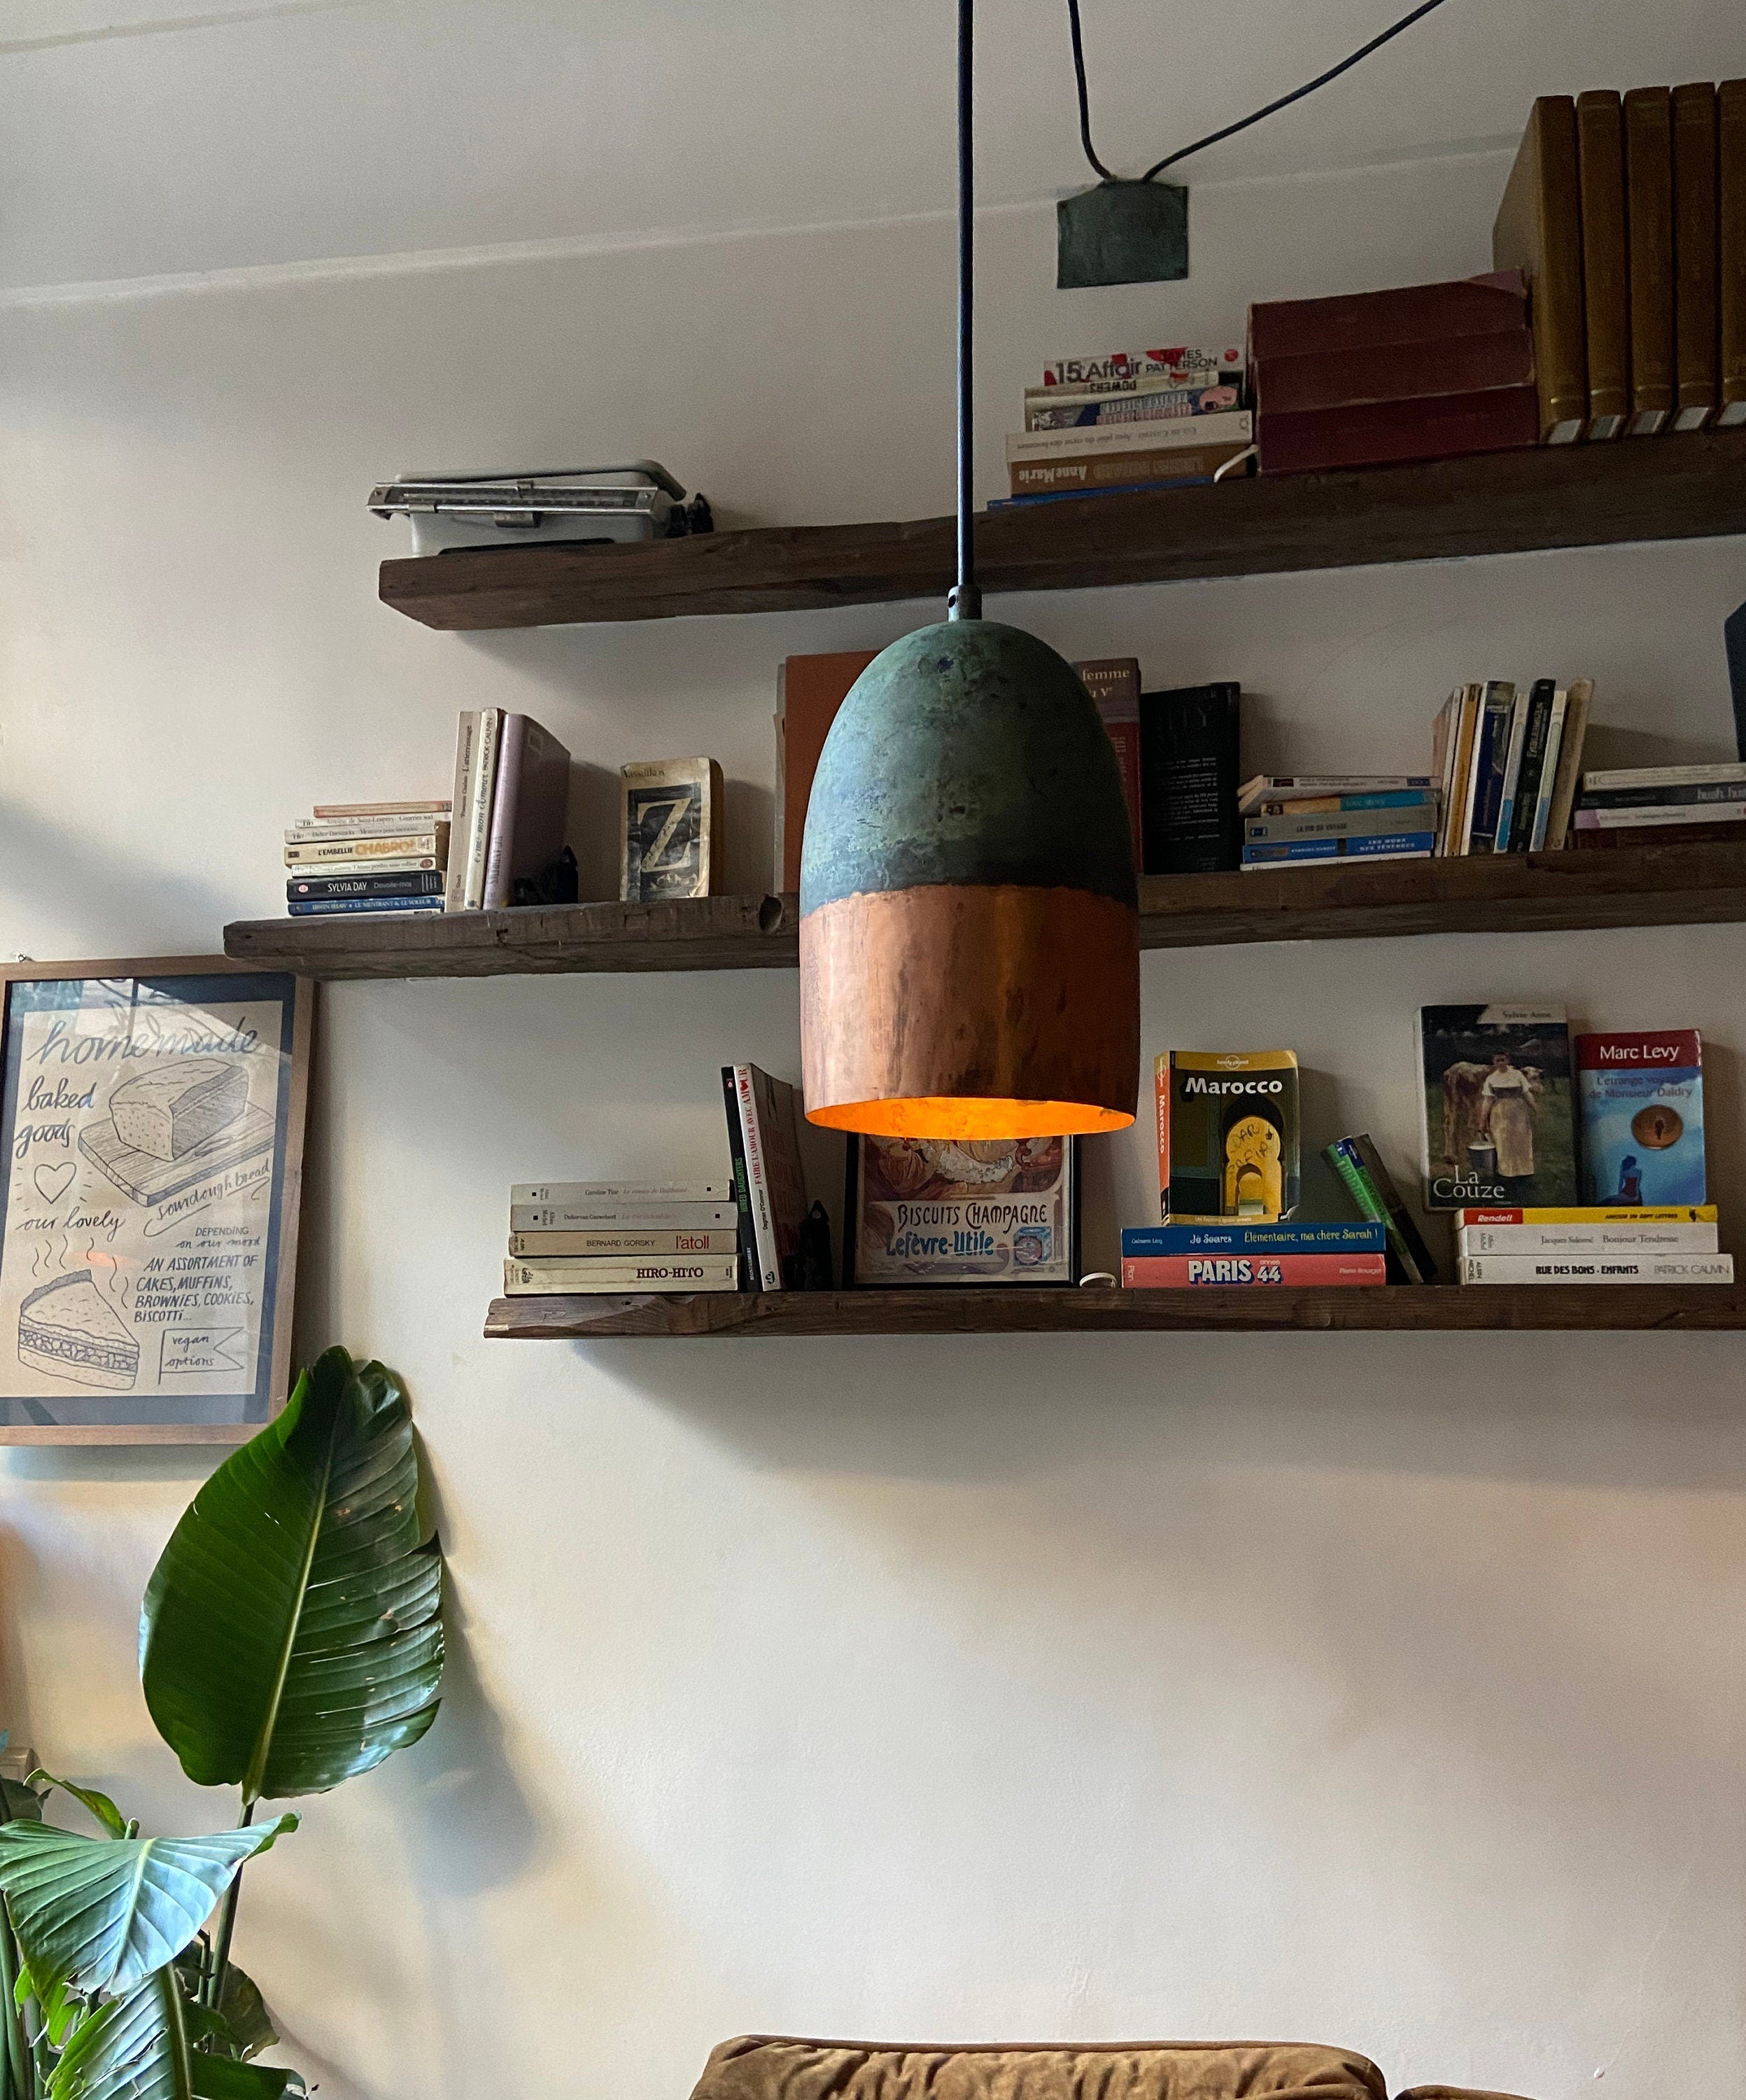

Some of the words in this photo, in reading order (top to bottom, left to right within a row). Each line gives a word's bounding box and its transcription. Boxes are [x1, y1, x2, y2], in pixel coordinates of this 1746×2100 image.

[1086, 357, 1142, 380] Affair
[1146, 356, 1218, 374] PATTERSON
[1089, 380, 1137, 393] POWERS
[1081, 668, 1131, 680] femme
[484, 717, 493, 745] CAUVIN
[477, 813, 485, 834] mon
[638, 797, 694, 873] Z
[318, 846, 353, 856] L'EMBELLIE
[328, 882, 352, 892] SYLVIA
[353, 881, 367, 891] DAY
[1502, 1010, 1528, 1020] Sylvie
[27, 1016, 262, 1065] homemade
[1600, 1046, 1640, 1060] Marc
[1643, 1044, 1680, 1062] Levy
[22, 1075, 97, 1112] baked
[1185, 1077, 1283, 1094] Marocco
[1589, 1090, 1601, 1099] de
[1605, 1089, 1654, 1098] Monsieur
[1657, 1088, 1694, 1099] Daldry
[745, 1106, 754, 1126] AVEC
[15, 1118, 75, 1159] goods
[748, 1126, 760, 1161] L'AMOUR
[735, 1156, 747, 1193] DAUGHTERS
[752, 1161, 762, 1185] FAIRE
[1454, 1164, 1479, 1184] La
[157, 1181, 233, 1220] sourdough
[235, 1158, 272, 1188] bread
[1432, 1178, 1505, 1199] Couze
[739, 1195, 748, 1213] HIRED
[15, 1216, 60, 1231] our
[62, 1205, 127, 1242] lovely
[897, 1203, 961, 1232] BISCUITS
[965, 1202, 1048, 1234] CHAMPAGNE
[1478, 1214, 1512, 1223] Rendell
[175, 1240, 192, 1249] on
[197, 1239, 222, 1248] our
[226, 1236, 260, 1247] mood
[675, 1235, 710, 1250] l'atoll
[885, 1230, 995, 1258] Lefèvre-Utile
[1203, 1233, 1232, 1244] Soares
[1301, 1232, 1315, 1241] ma
[1342, 1228, 1373, 1240] Sarah
[1540, 1236, 1567, 1246] Jacques
[1603, 1234, 1636, 1245] Bonjour
[1638, 1234, 1679, 1244] Tendresse
[143, 1258, 164, 1272] AN
[166, 1256, 241, 1271] ASSORTMENT
[243, 1255, 259, 1267] OF
[1188, 1260, 1253, 1284] PARIS
[1256, 1264, 1282, 1285] 44
[1535, 1266, 1552, 1275] RUE
[1554, 1266, 1570, 1275] DES
[1654, 1266, 1689, 1275] PATRICK
[1691, 1265, 1729, 1275] CAUVIN
[636, 1267, 704, 1279] HIRO-HITO
[172, 1336, 210, 1352] vegan
[164, 1356, 214, 1369] options
